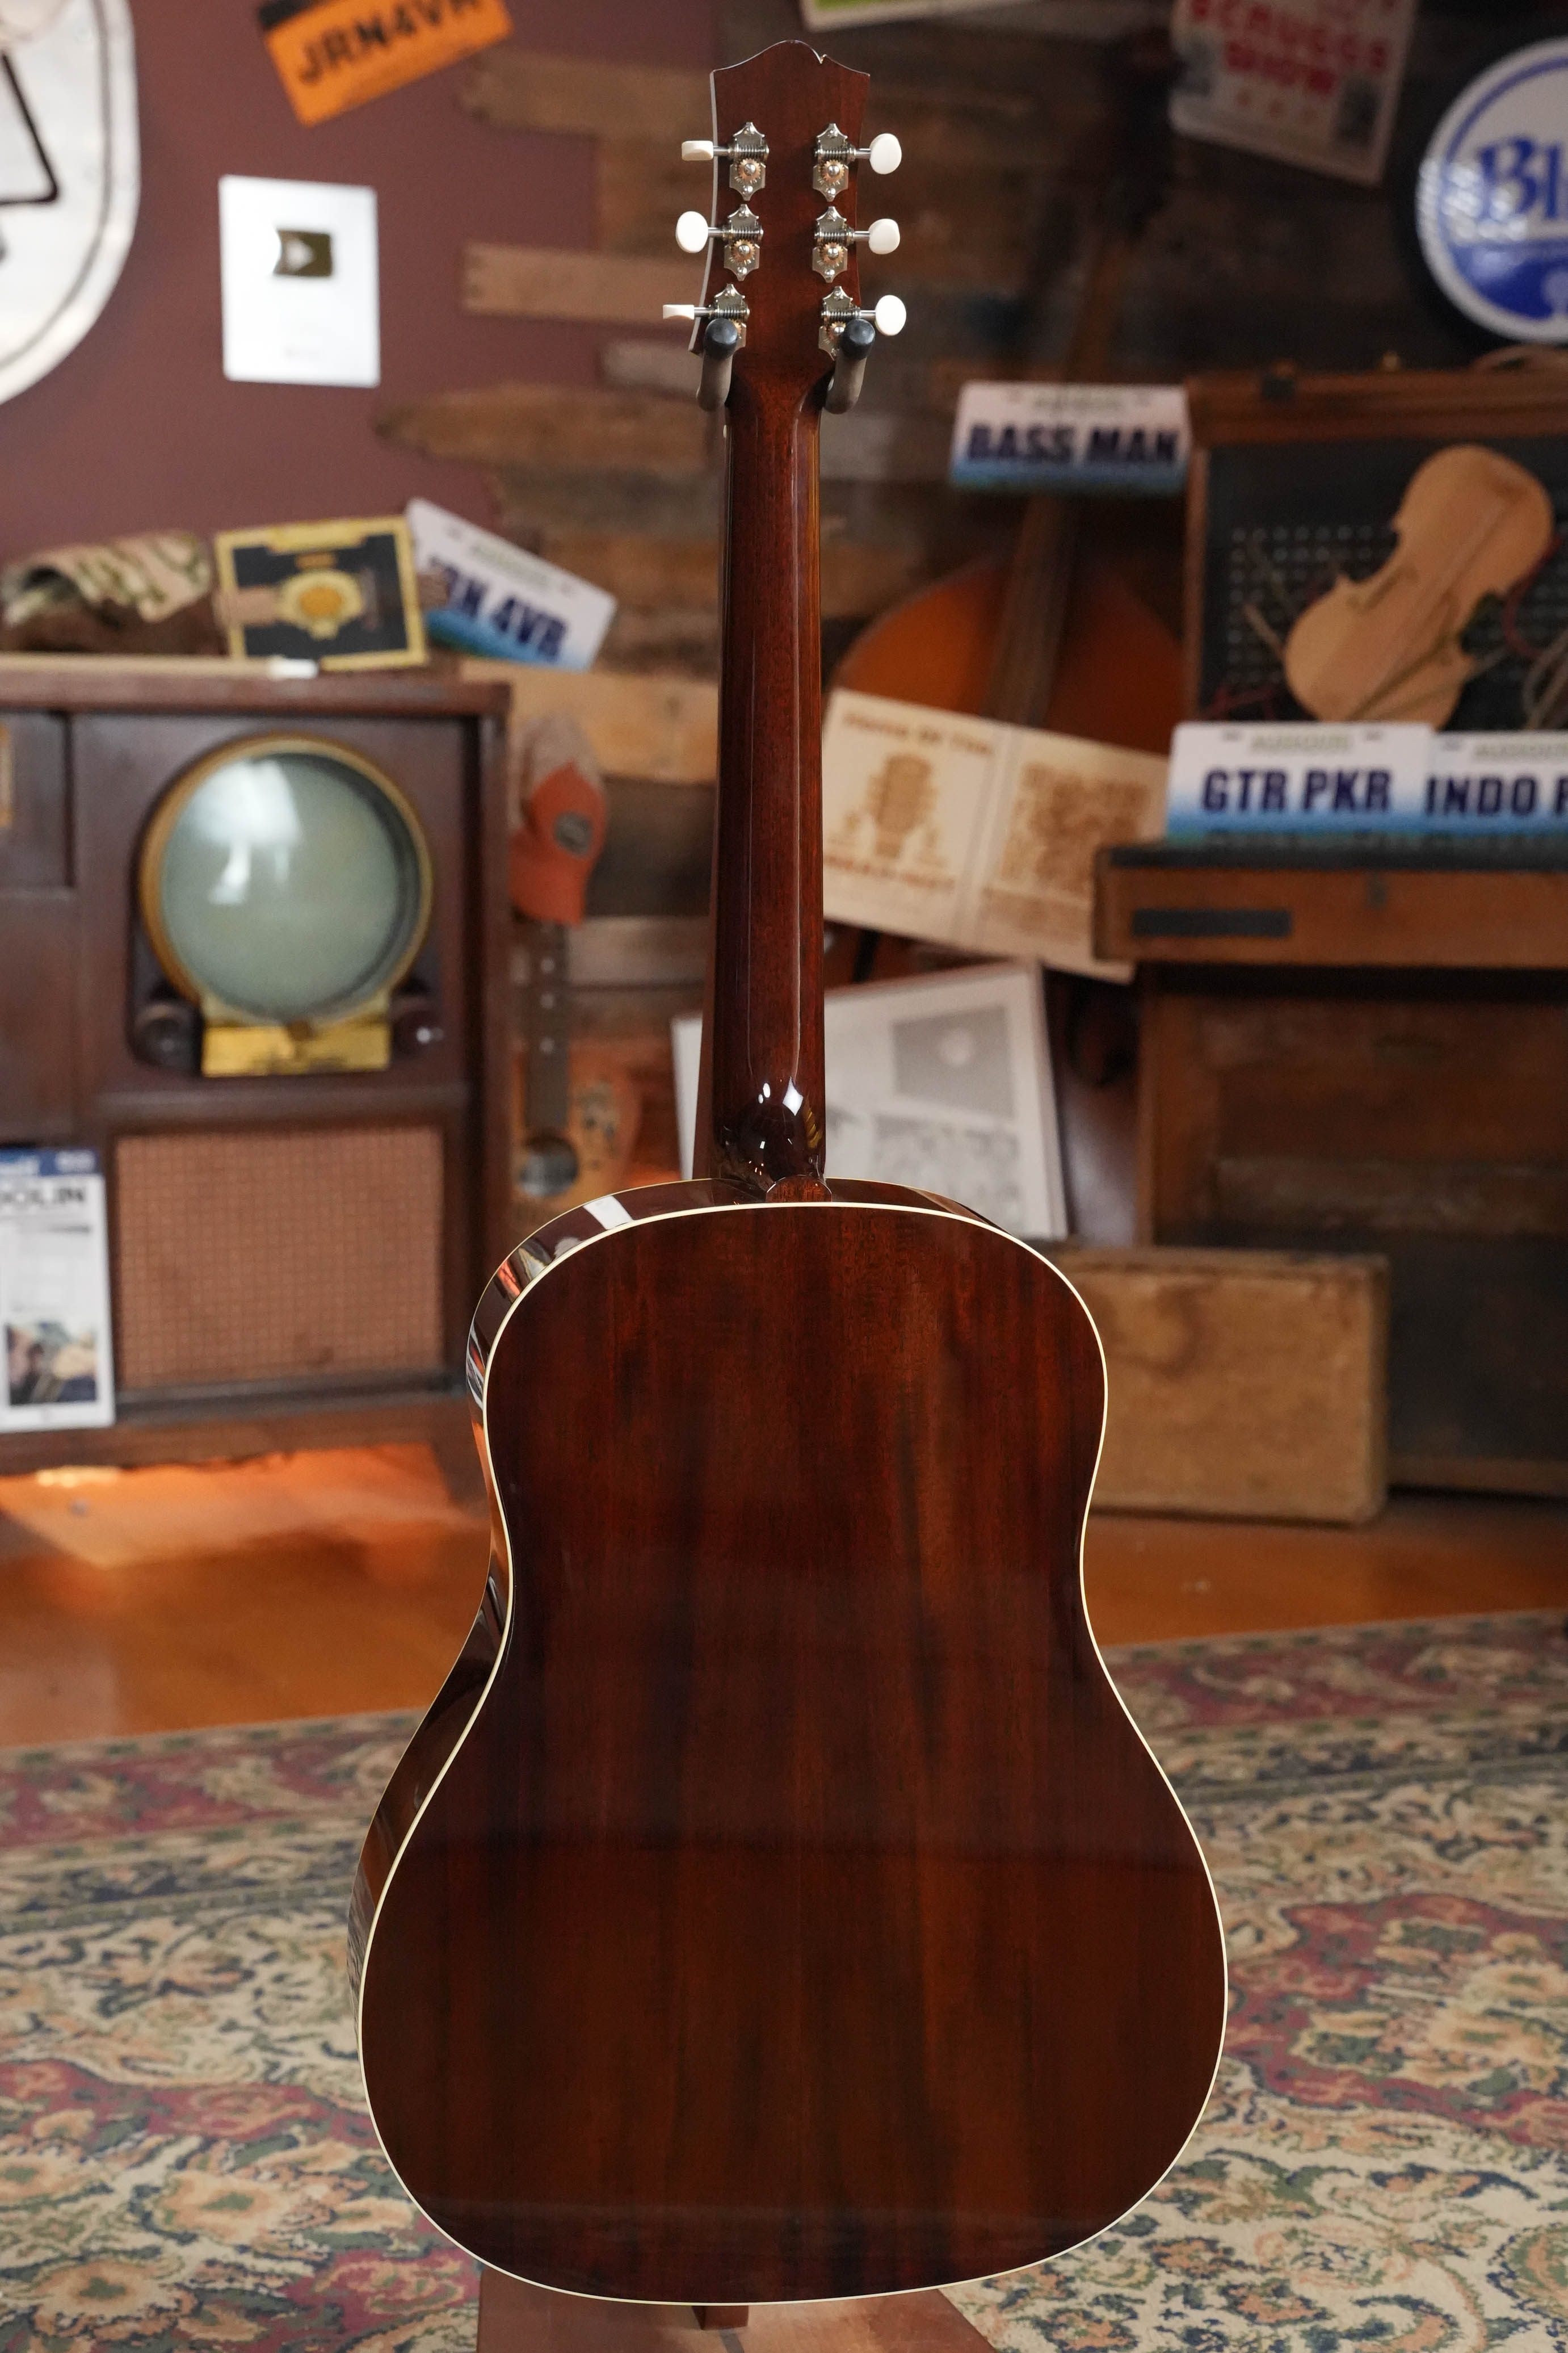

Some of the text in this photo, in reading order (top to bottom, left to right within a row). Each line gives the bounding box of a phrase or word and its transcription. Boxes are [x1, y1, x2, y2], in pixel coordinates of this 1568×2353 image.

[967, 424, 1178, 467] BASS MAN
[1201, 767, 1392, 812] GTR PKR
[1425, 775, 1536, 816] INDO
